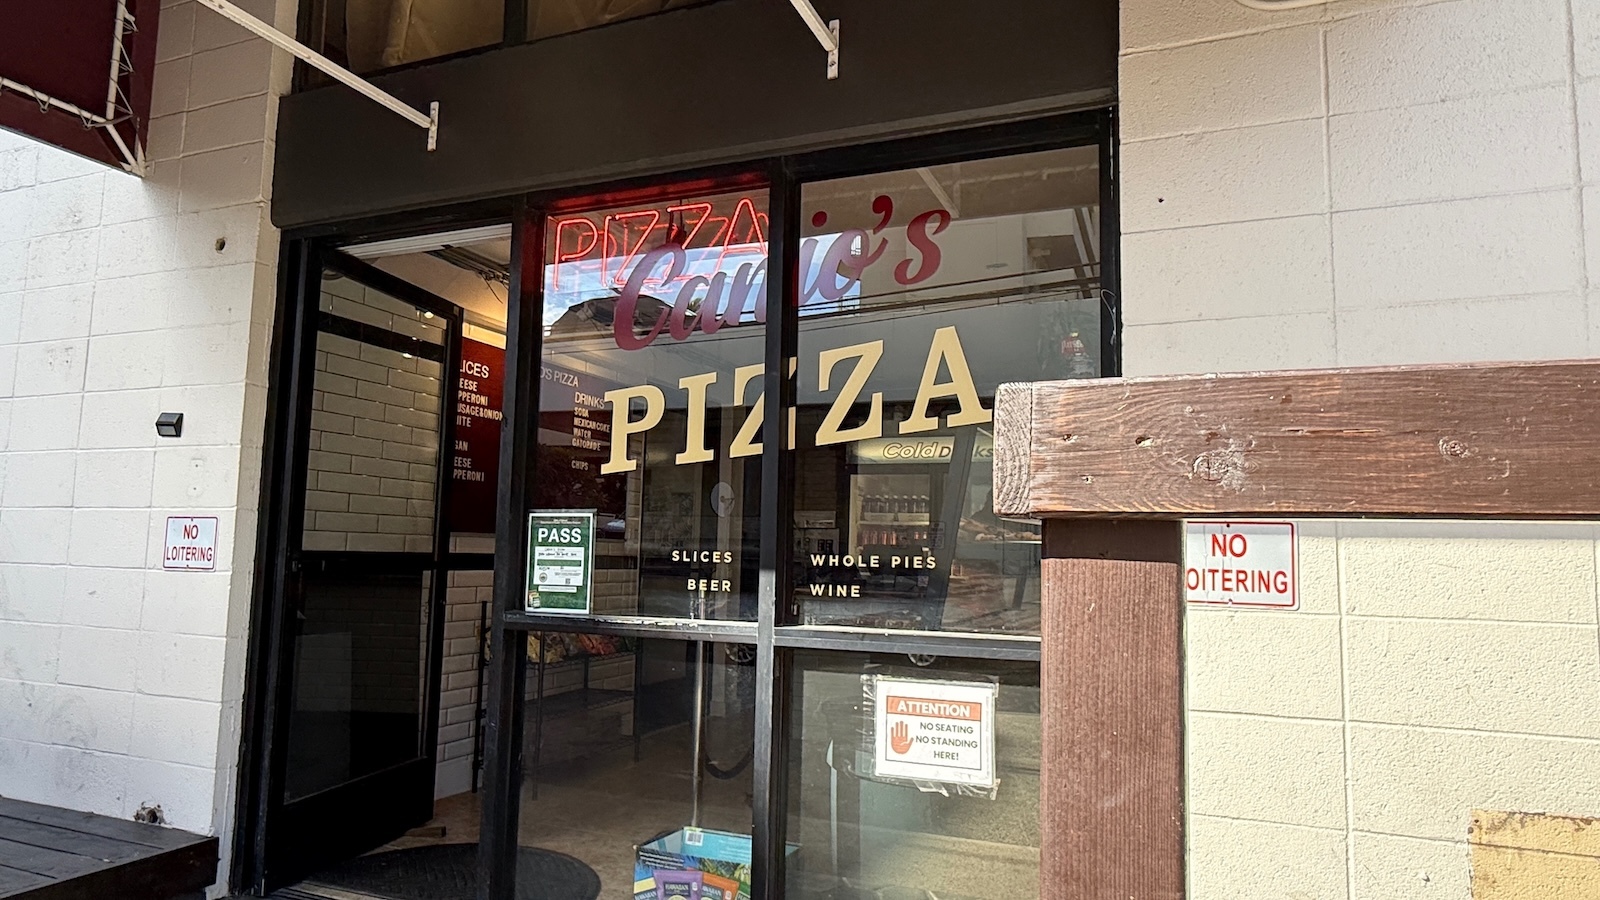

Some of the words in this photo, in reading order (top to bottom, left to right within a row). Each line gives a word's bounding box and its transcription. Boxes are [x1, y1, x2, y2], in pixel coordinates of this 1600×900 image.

[553, 198, 768, 292] PIZZA
[613, 194, 951, 351] Canio's
[460, 360, 490, 379] ICES
[553, 370, 579, 388] PIZZA
[574, 391, 605, 409] DRINKS
[600, 324, 994, 475] PIZZA
[883, 442, 938, 459] Cold
[571, 460, 589, 471] CHIPS
[183, 524, 199, 540] NO
[537, 527, 582, 544] PASS
[166, 546, 213, 562] LOITERING
[1211, 533, 1247, 558] NO
[671, 550, 733, 564] SLICES
[810, 554, 880, 568] WHOLE
[891, 555, 937, 569] PIES
[687, 578, 732, 593] BEER
[1186, 567, 1288, 594] OITERING
[810, 584, 861, 598] WINE
[897, 700, 971, 718] ATTENTION
[919, 721, 934, 731] NO
[935, 723, 974, 735] SEATING
[915, 736, 930, 745] NO
[931, 737, 979, 750] STANDING
[933, 750, 960, 761] HERE!
